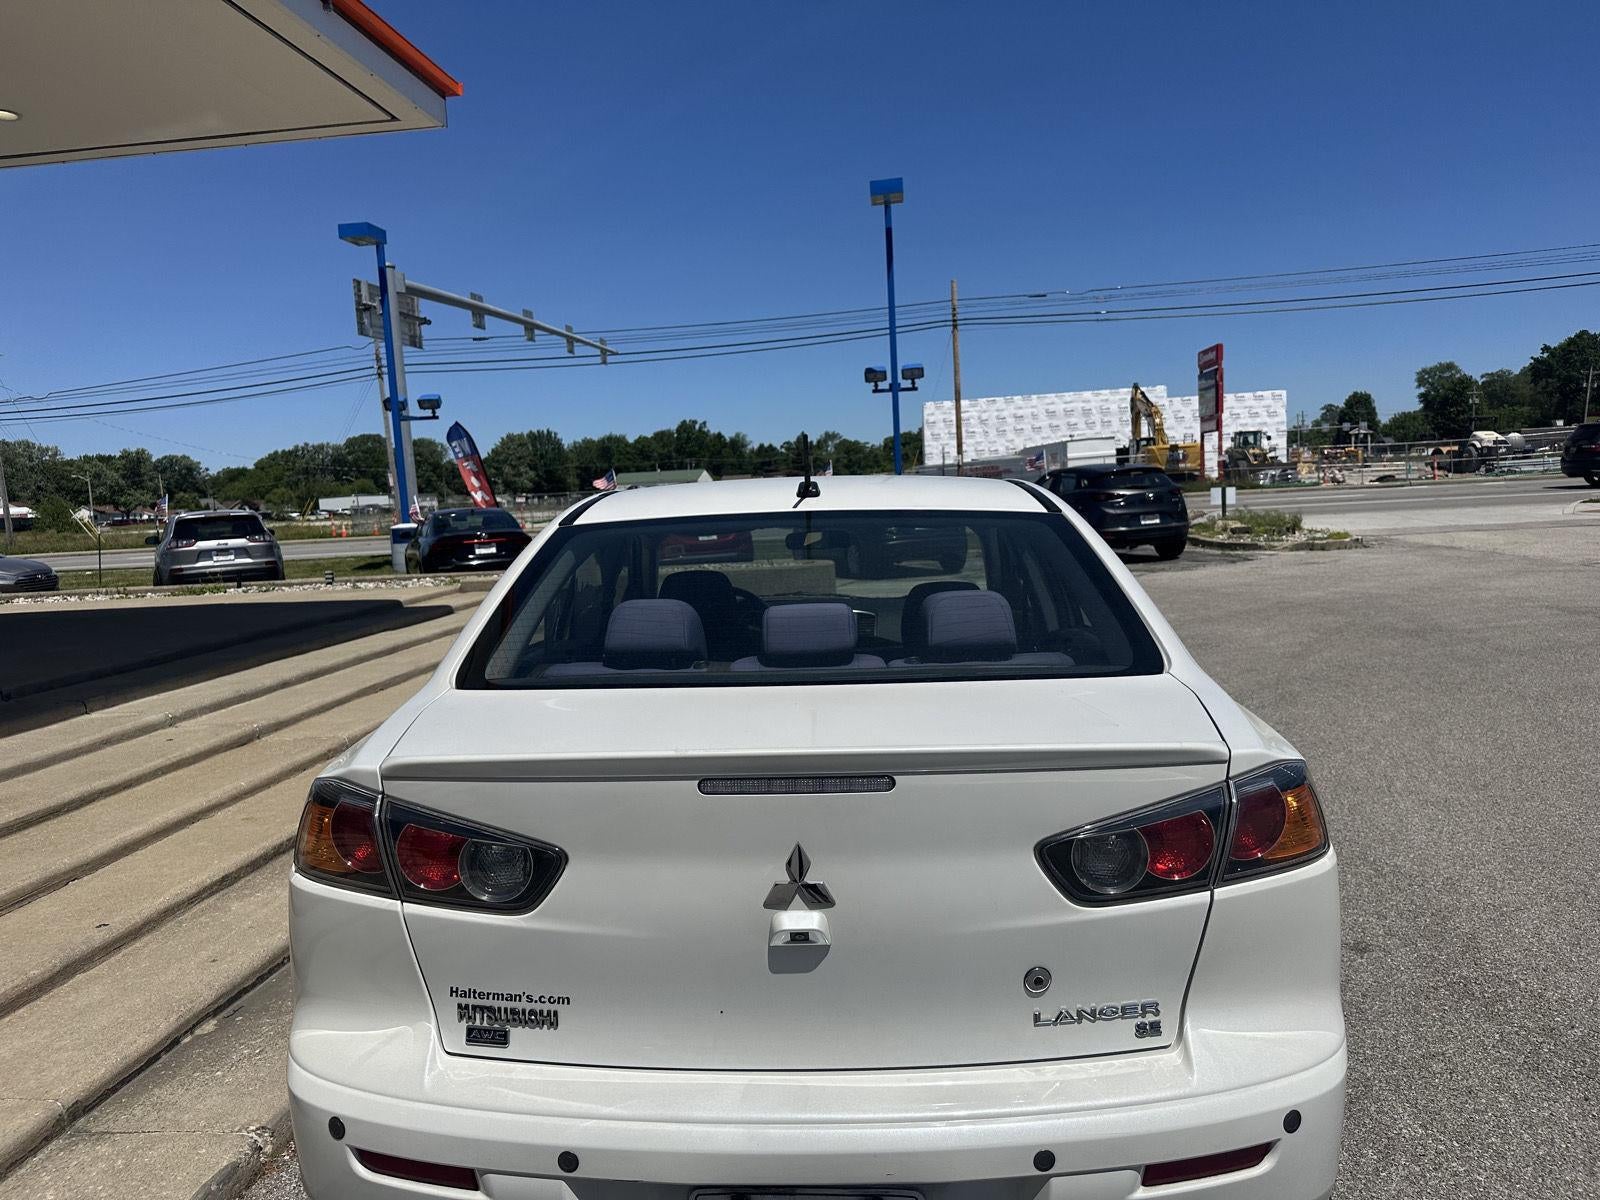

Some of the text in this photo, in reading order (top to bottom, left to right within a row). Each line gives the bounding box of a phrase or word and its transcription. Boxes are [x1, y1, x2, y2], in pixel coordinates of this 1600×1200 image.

[450, 986, 571, 1005] Halterman's.com
[457, 1003, 559, 1030] MITSUBISHI
[1033, 1001, 1161, 1028] LANCER
[470, 1029, 506, 1041] AWC
[1135, 1020, 1163, 1038] SE
